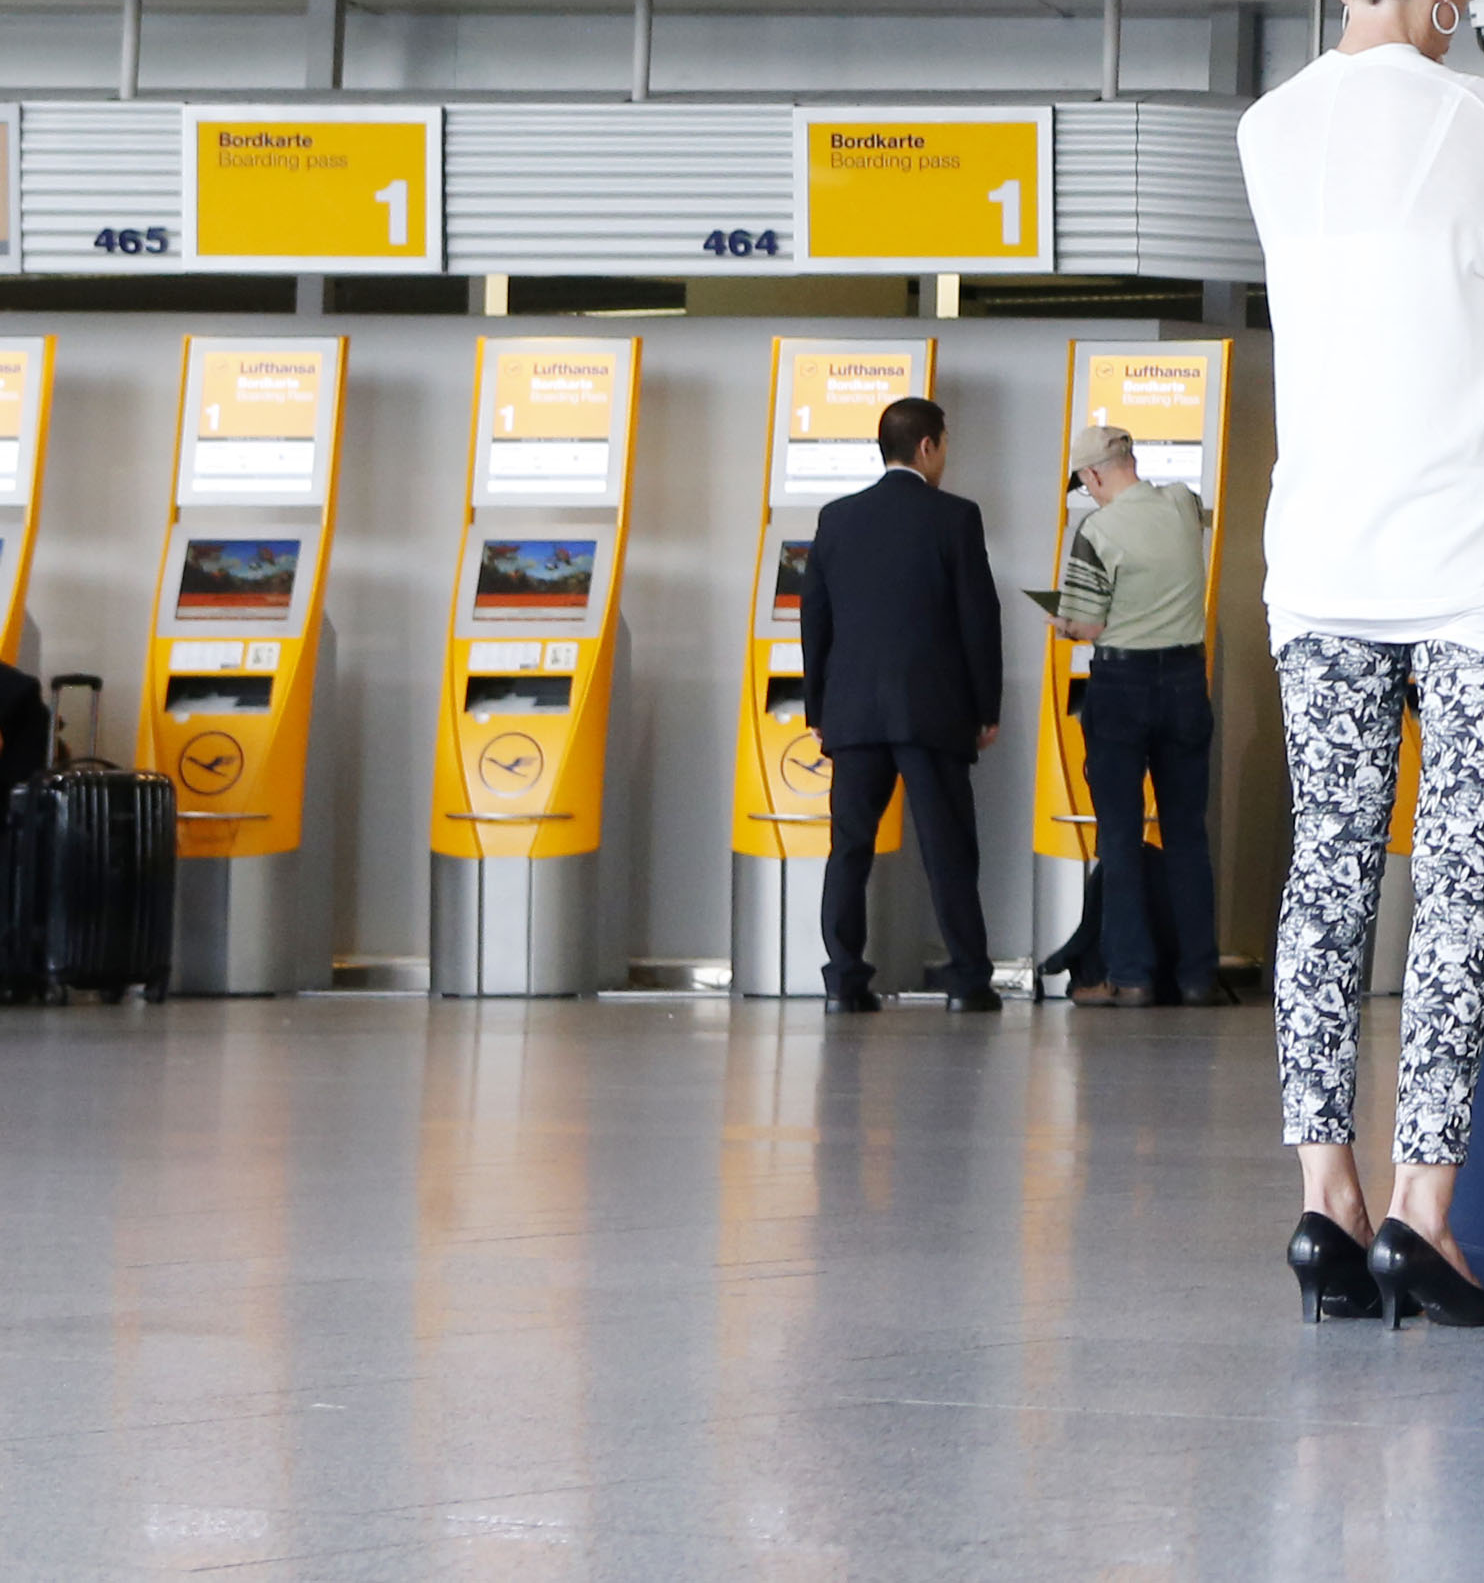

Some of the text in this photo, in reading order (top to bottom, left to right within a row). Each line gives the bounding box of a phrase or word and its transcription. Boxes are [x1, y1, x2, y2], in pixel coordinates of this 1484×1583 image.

[219, 132, 312, 148] Bordkarte
[831, 133, 925, 149] Bordkarte
[219, 149, 348, 171] Boarding pass
[831, 151, 960, 173] Boarding pass
[375, 180, 408, 245] 1
[988, 180, 1020, 244] 1
[94, 228, 167, 255] 465
[704, 230, 778, 257] 464
[533, 363, 608, 375] Lufthansa
[829, 363, 904, 376] Lufthansa
[1125, 365, 1200, 377] Lufthansa
[206, 404, 220, 431] 1
[500, 405, 515, 432] 1
[796, 406, 811, 432] 1
